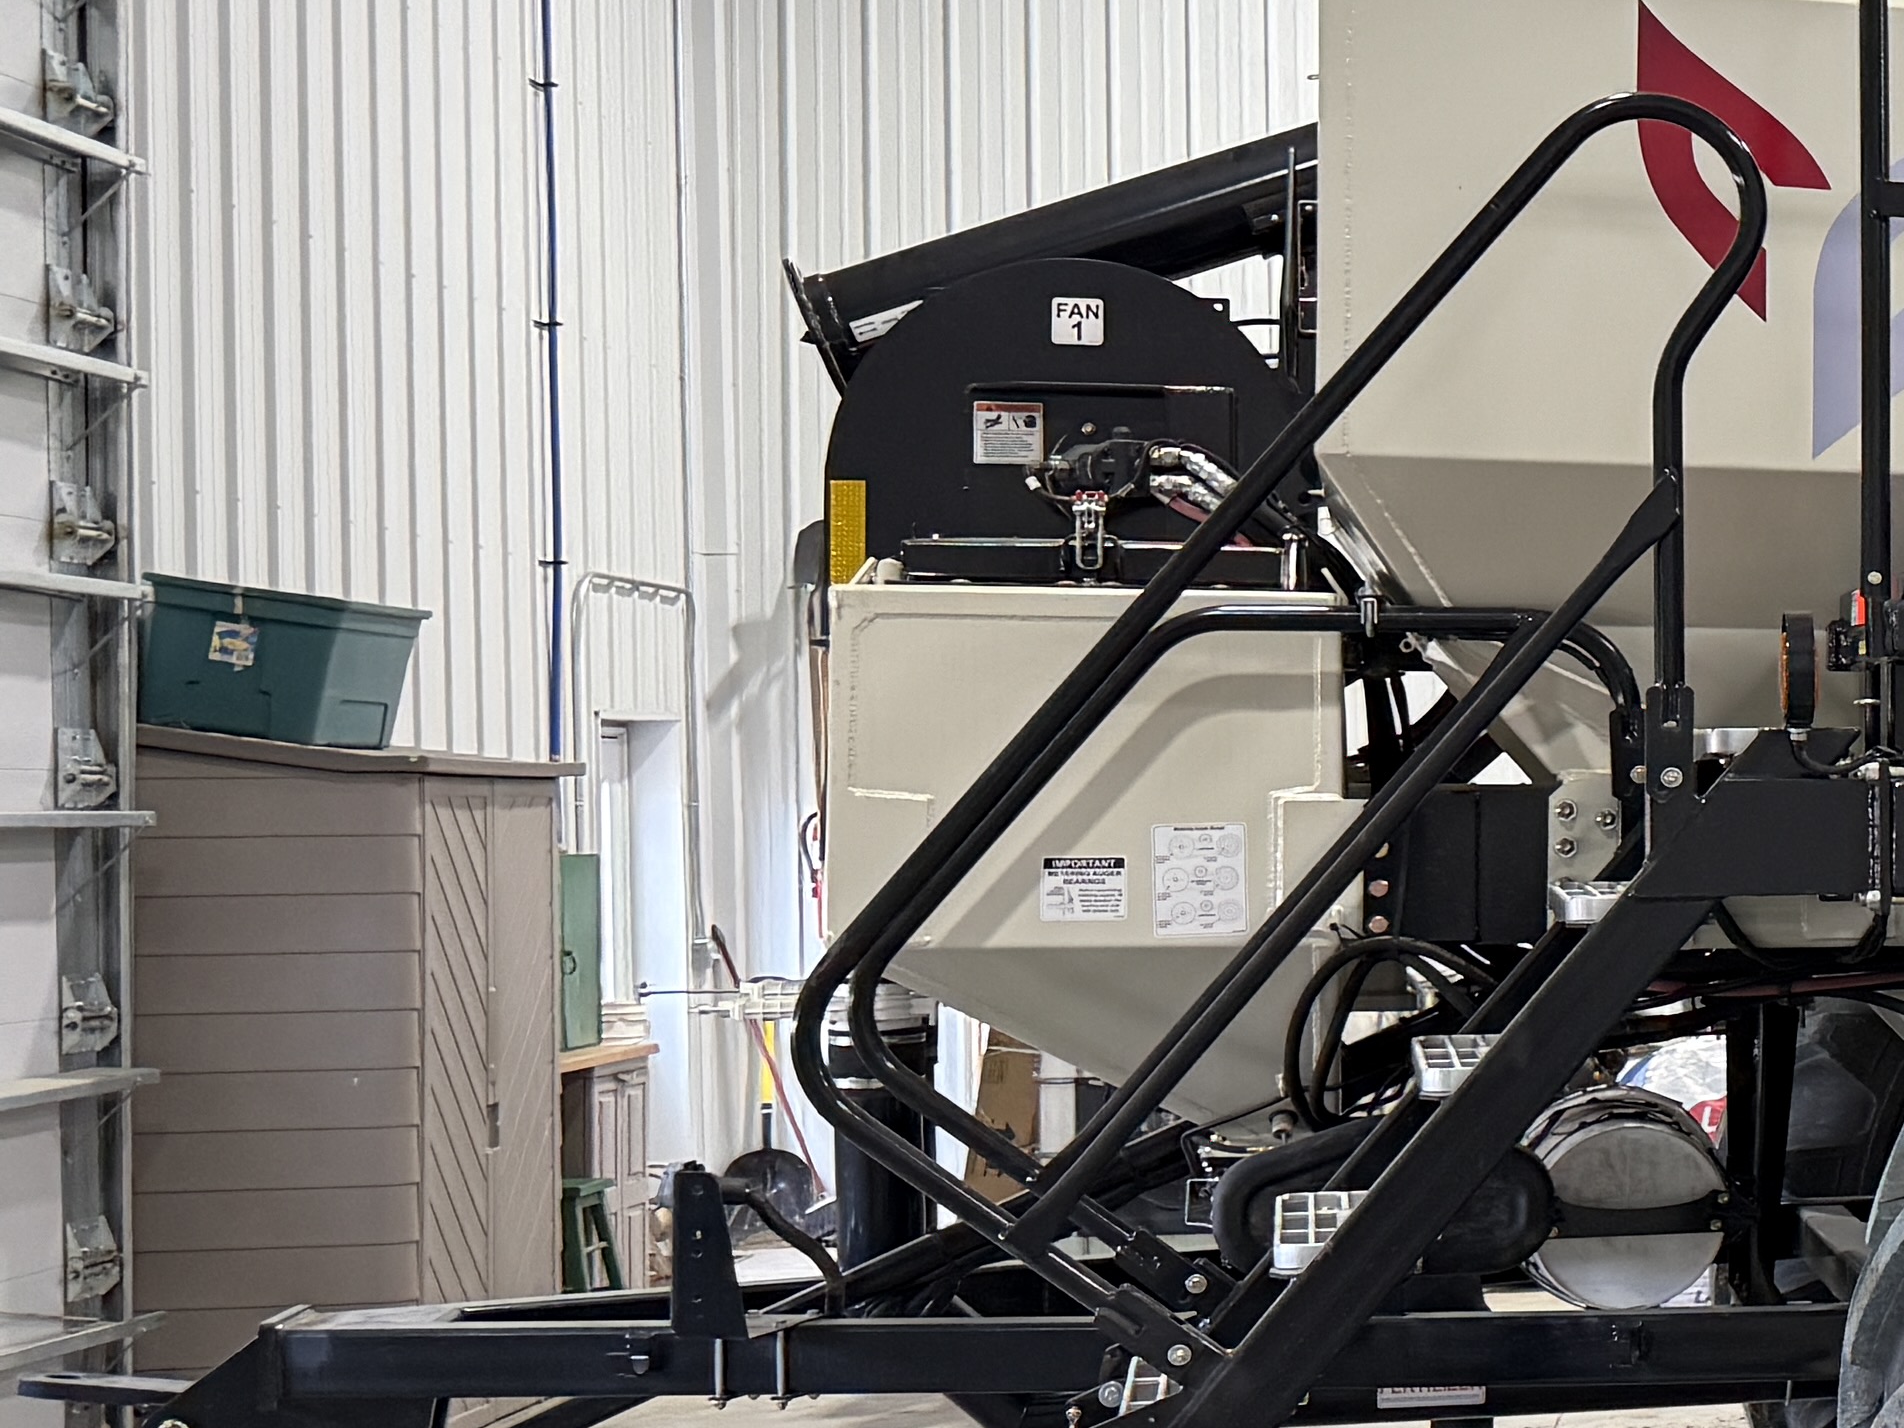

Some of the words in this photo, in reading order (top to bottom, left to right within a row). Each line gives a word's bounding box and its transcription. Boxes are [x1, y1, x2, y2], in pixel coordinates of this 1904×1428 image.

[1056, 302, 1100, 320] FAN
[1071, 320, 1082, 341] 1
[1052, 859, 1115, 867] IMPORTANT
